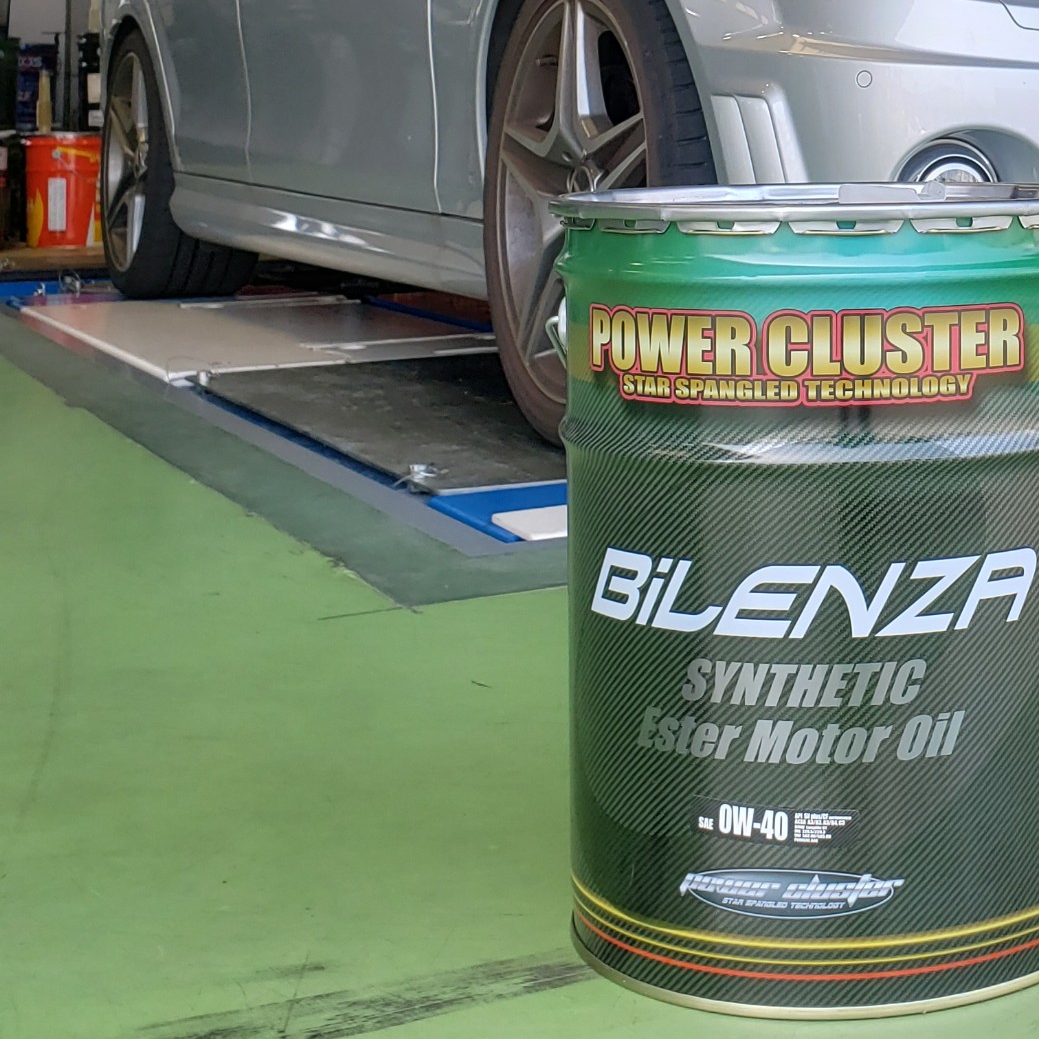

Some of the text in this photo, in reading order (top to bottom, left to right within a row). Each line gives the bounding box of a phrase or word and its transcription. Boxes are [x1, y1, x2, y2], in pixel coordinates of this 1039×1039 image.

[591, 308, 1021, 376] POWER CLUSTER
[622, 373, 972, 402] STAR SPANGLED TECHNOLOGY
[681, 658, 927, 708] SYNTHETIC
[638, 706, 966, 764] Ester Motor Oil
[698, 803, 789, 841] SAE 0W-40
[679, 872, 905, 907] power cluster
[721, 897, 845, 910] STAR SPANGLED TECHNOLOGY
